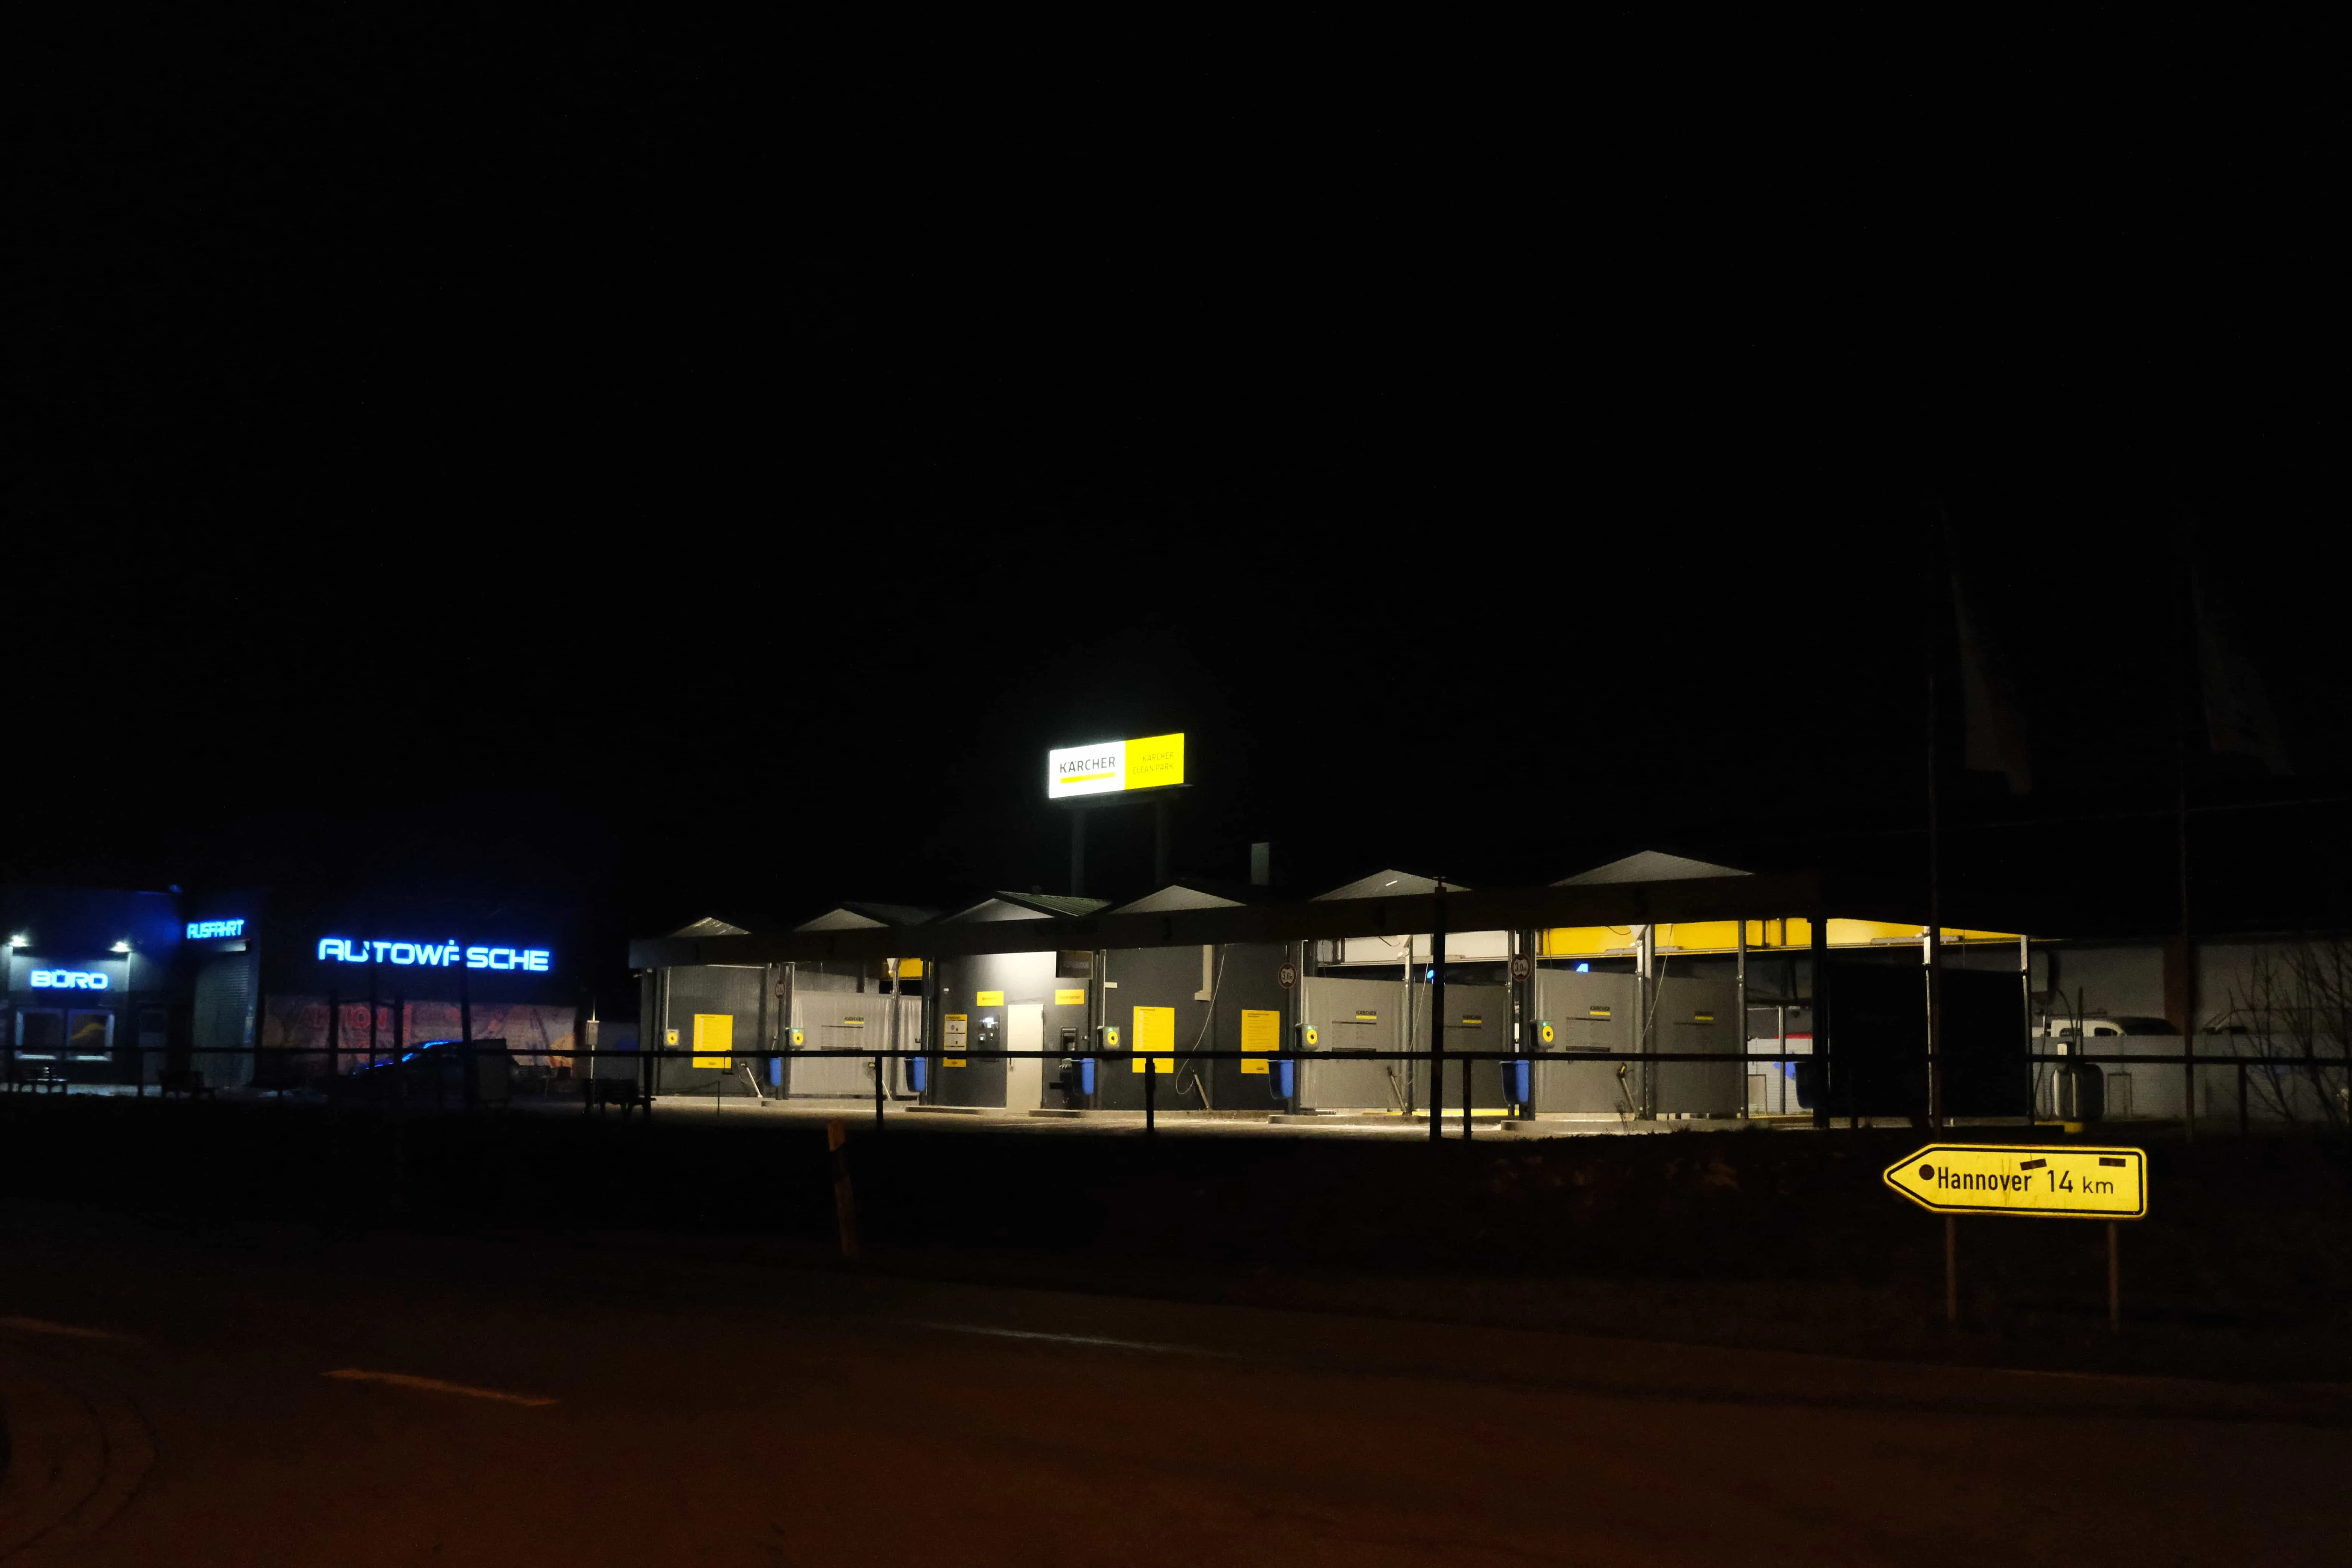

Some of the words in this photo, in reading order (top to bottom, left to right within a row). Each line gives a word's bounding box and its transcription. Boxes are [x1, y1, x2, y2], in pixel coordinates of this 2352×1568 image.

[1060, 756, 1115, 773] KÄRCHER
[1133, 765, 1154, 774] CLEAN
[1155, 763, 1173, 772] PARK
[187, 919, 245, 939] AUSFAHRT
[31, 969, 109, 989] BÜRO
[1938, 1167, 2032, 1191] Hannover
[2047, 1170, 2073, 1193] 14
[2082, 1176, 2114, 1194] km
